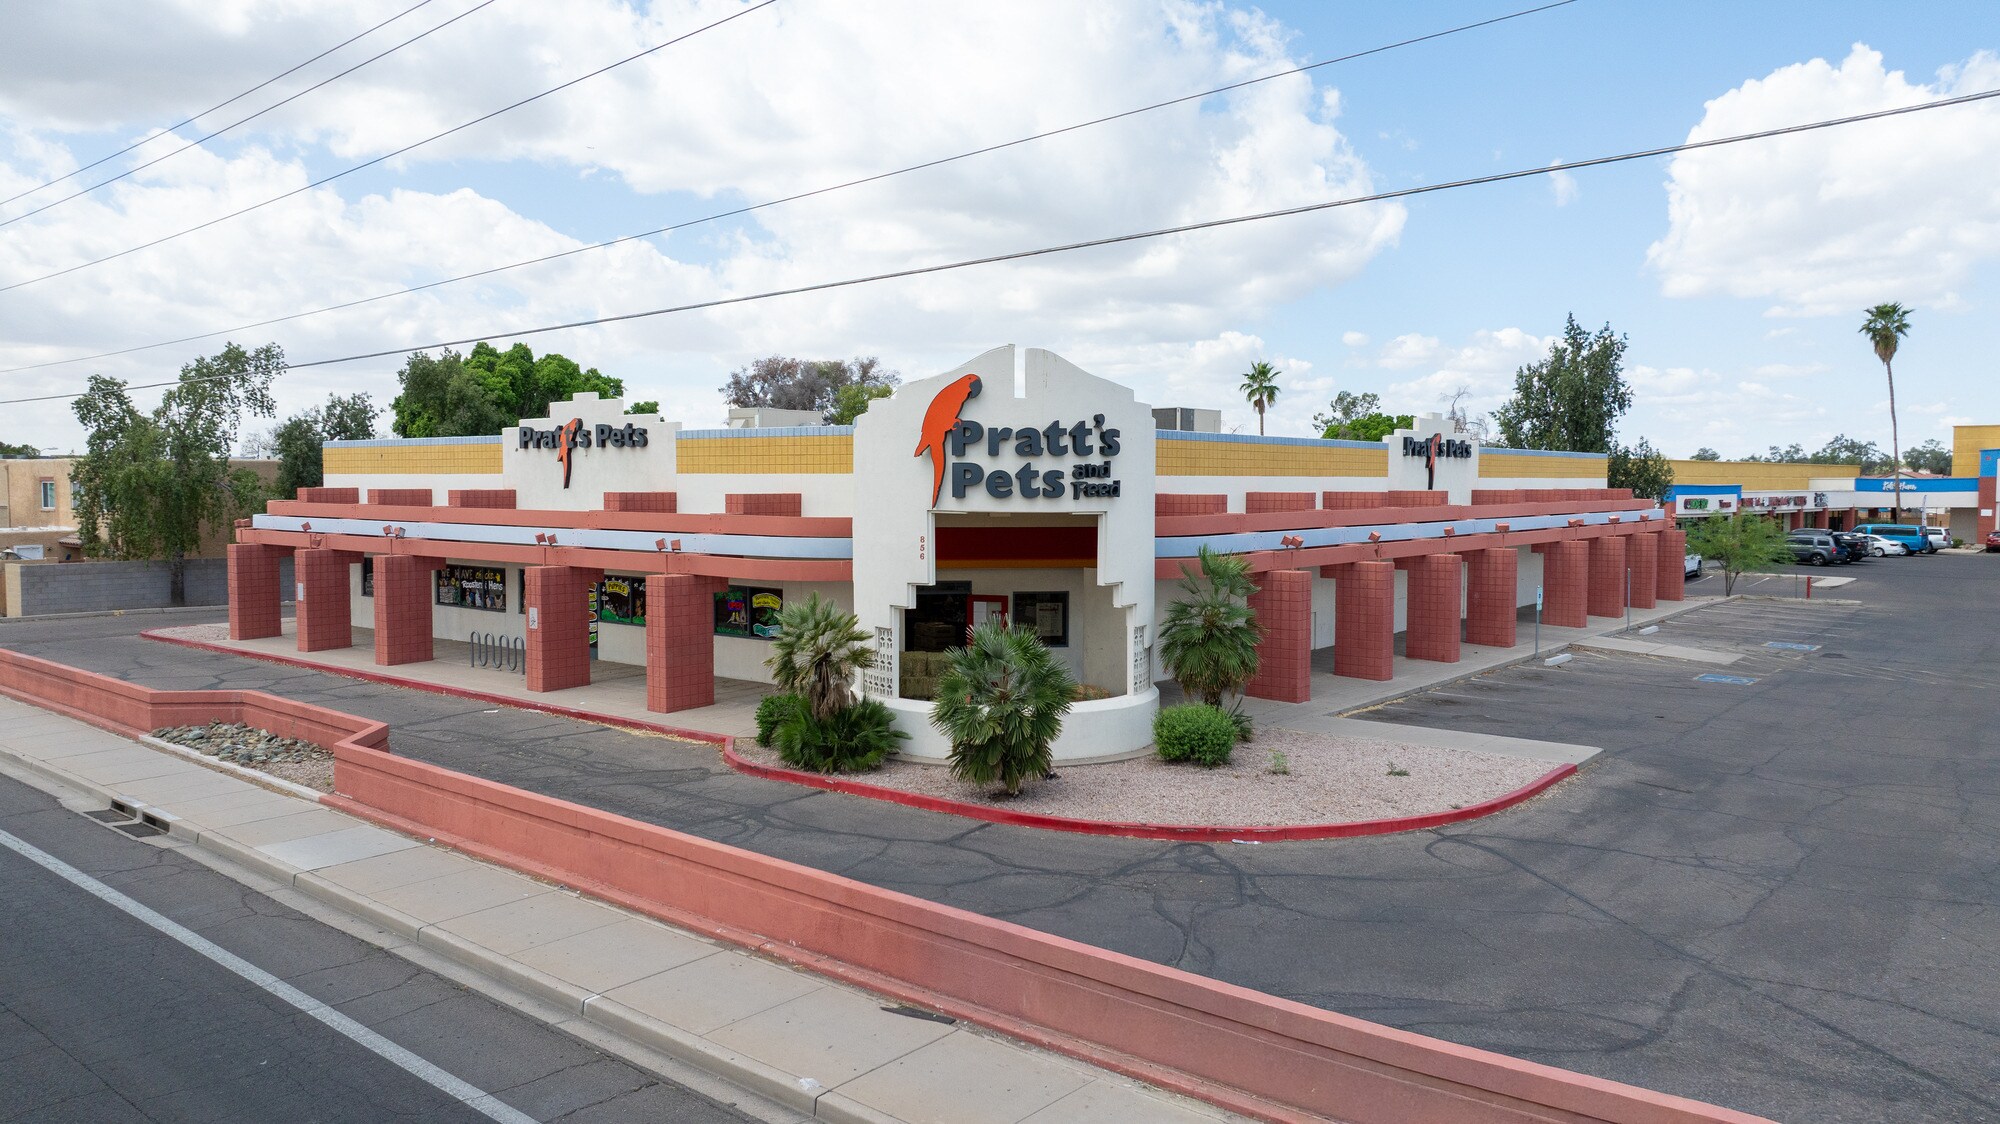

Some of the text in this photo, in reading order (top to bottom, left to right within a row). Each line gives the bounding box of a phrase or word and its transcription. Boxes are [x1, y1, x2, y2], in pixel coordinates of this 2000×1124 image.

[595, 422, 648, 448] Pets
[951, 413, 1121, 457] Pratt's
[1403, 437, 1471, 458] Pratts Pets
[951, 462, 1065, 499] Pets
[1071, 460, 1112, 480] and
[1070, 480, 1121, 501] Feed
[455, 569, 473, 579] HAVE
[475, 571, 494, 579] chcks
[488, 581, 503, 590] Hens
